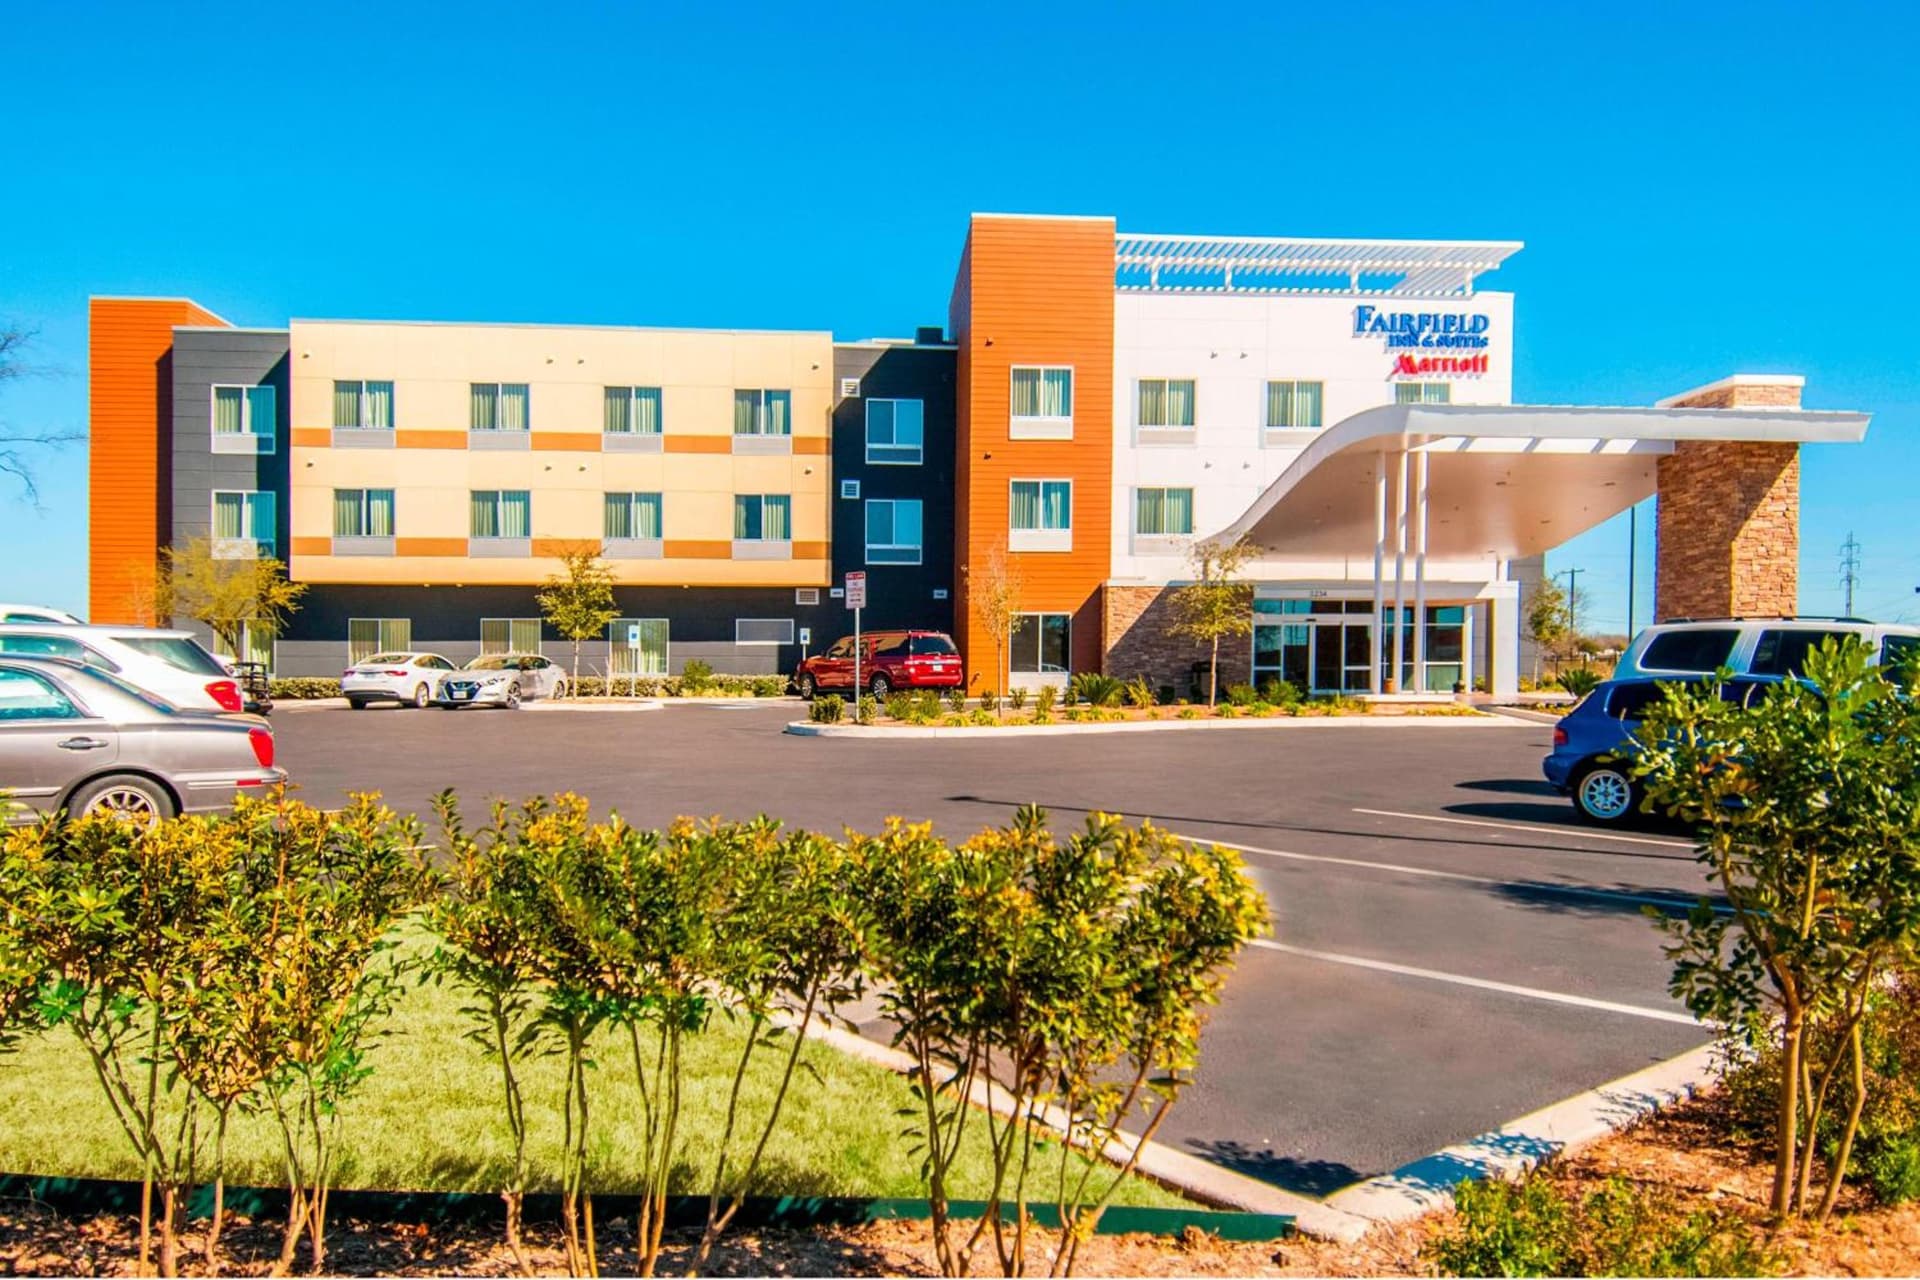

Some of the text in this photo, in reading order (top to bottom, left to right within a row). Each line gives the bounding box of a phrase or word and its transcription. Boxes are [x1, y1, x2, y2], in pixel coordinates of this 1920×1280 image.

[1355, 304, 1490, 334] FAIRFIELD
[1387, 335, 1489, 348] INN & SUITES
[1388, 353, 1489, 375] Marriott
